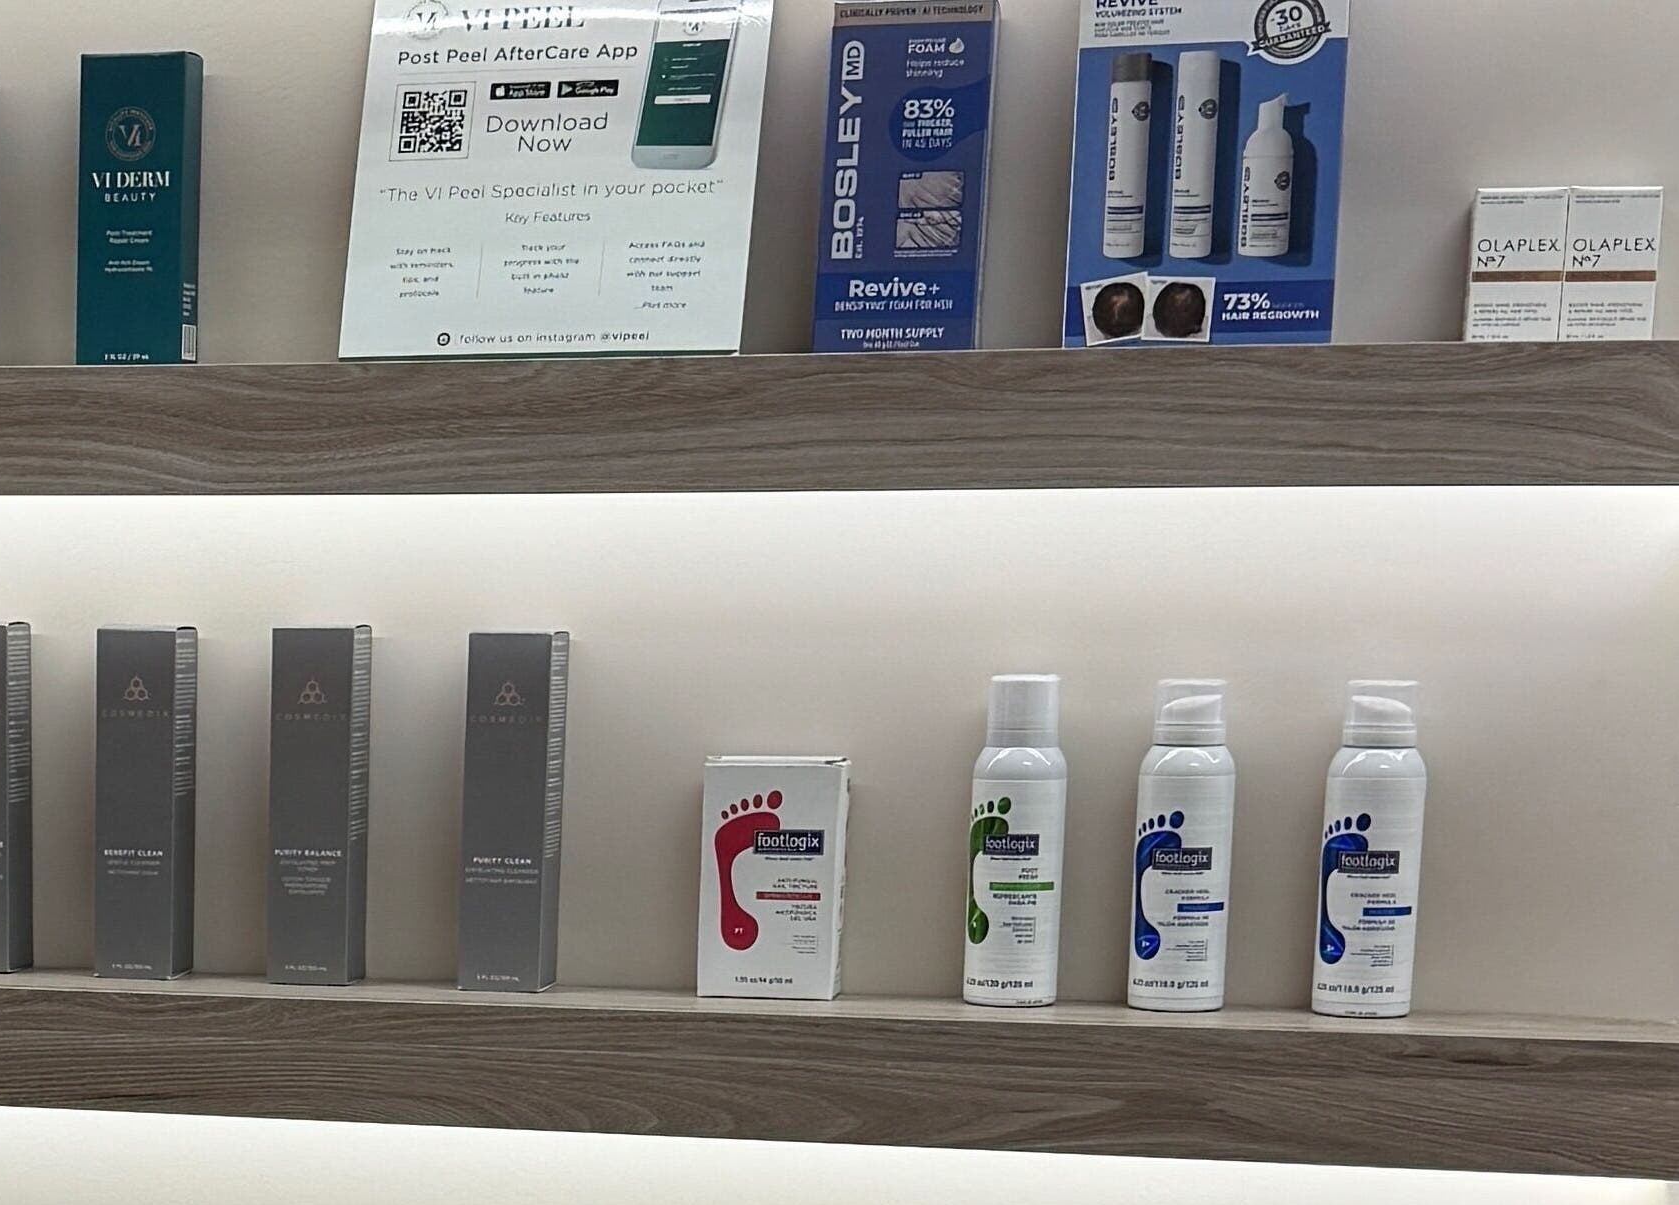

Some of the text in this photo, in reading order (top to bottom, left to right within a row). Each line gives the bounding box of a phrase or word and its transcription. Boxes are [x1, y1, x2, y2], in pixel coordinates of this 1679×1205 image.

[839, 8, 883, 19] CLINICALLY
[885, 7, 917, 18] PROVEN
[931, 4, 985, 16] TECHNOLOGY
[1095, 7, 1182, 19] VOLUMIZING SYSTEM
[1274, 5, 1304, 26] 30
[1258, 24, 1326, 49] GUARANTEED
[398, 44, 638, 65] Post Peel AfterCare App
[907, 43, 946, 54] FOAM
[933, 58, 965, 67] reduce
[906, 69, 944, 79] thinning
[903, 98, 955, 119] 83%
[486, 112, 609, 134] Download
[902, 128, 954, 138] FULLER HAIR
[517, 135, 573, 153] Now
[902, 138, 953, 148] IN 45 DAYS
[830, 45, 863, 260] BOSLEY MD
[92, 170, 170, 188] VI DERM
[104, 192, 157, 202] BEAUTY
[424, 187, 442, 200] VI
[492, 182, 576, 200] Specialist
[583, 182, 599, 197] in
[604, 180, 645, 199] your
[533, 210, 591, 223] Features
[1477, 238, 1561, 253] OLAPLEX
[1572, 237, 1657, 252] OLAPLEX
[848, 276, 941, 298] Revive+
[888, 300, 914, 311] FOAM
[915, 300, 932, 310] FOR
[1222, 292, 1271, 310] 73%
[1221, 309, 1320, 321] HAIR REGROWTH
[459, 333, 496, 344] follow
[499, 335, 513, 344] us
[517, 333, 532, 343] on
[536, 330, 596, 344] instagram
[840, 327, 945, 340] TWO MONTH SUPPLY
[756, 832, 820, 852] footlogix
[985, 835, 1036, 854] footlogix
[137, 849, 164, 857] CLEAN
[304, 849, 342, 858] BALANCE
[1155, 850, 1210, 867] footlogix
[504, 857, 532, 865] CLEAN
[1340, 852, 1397, 870] footlogix
